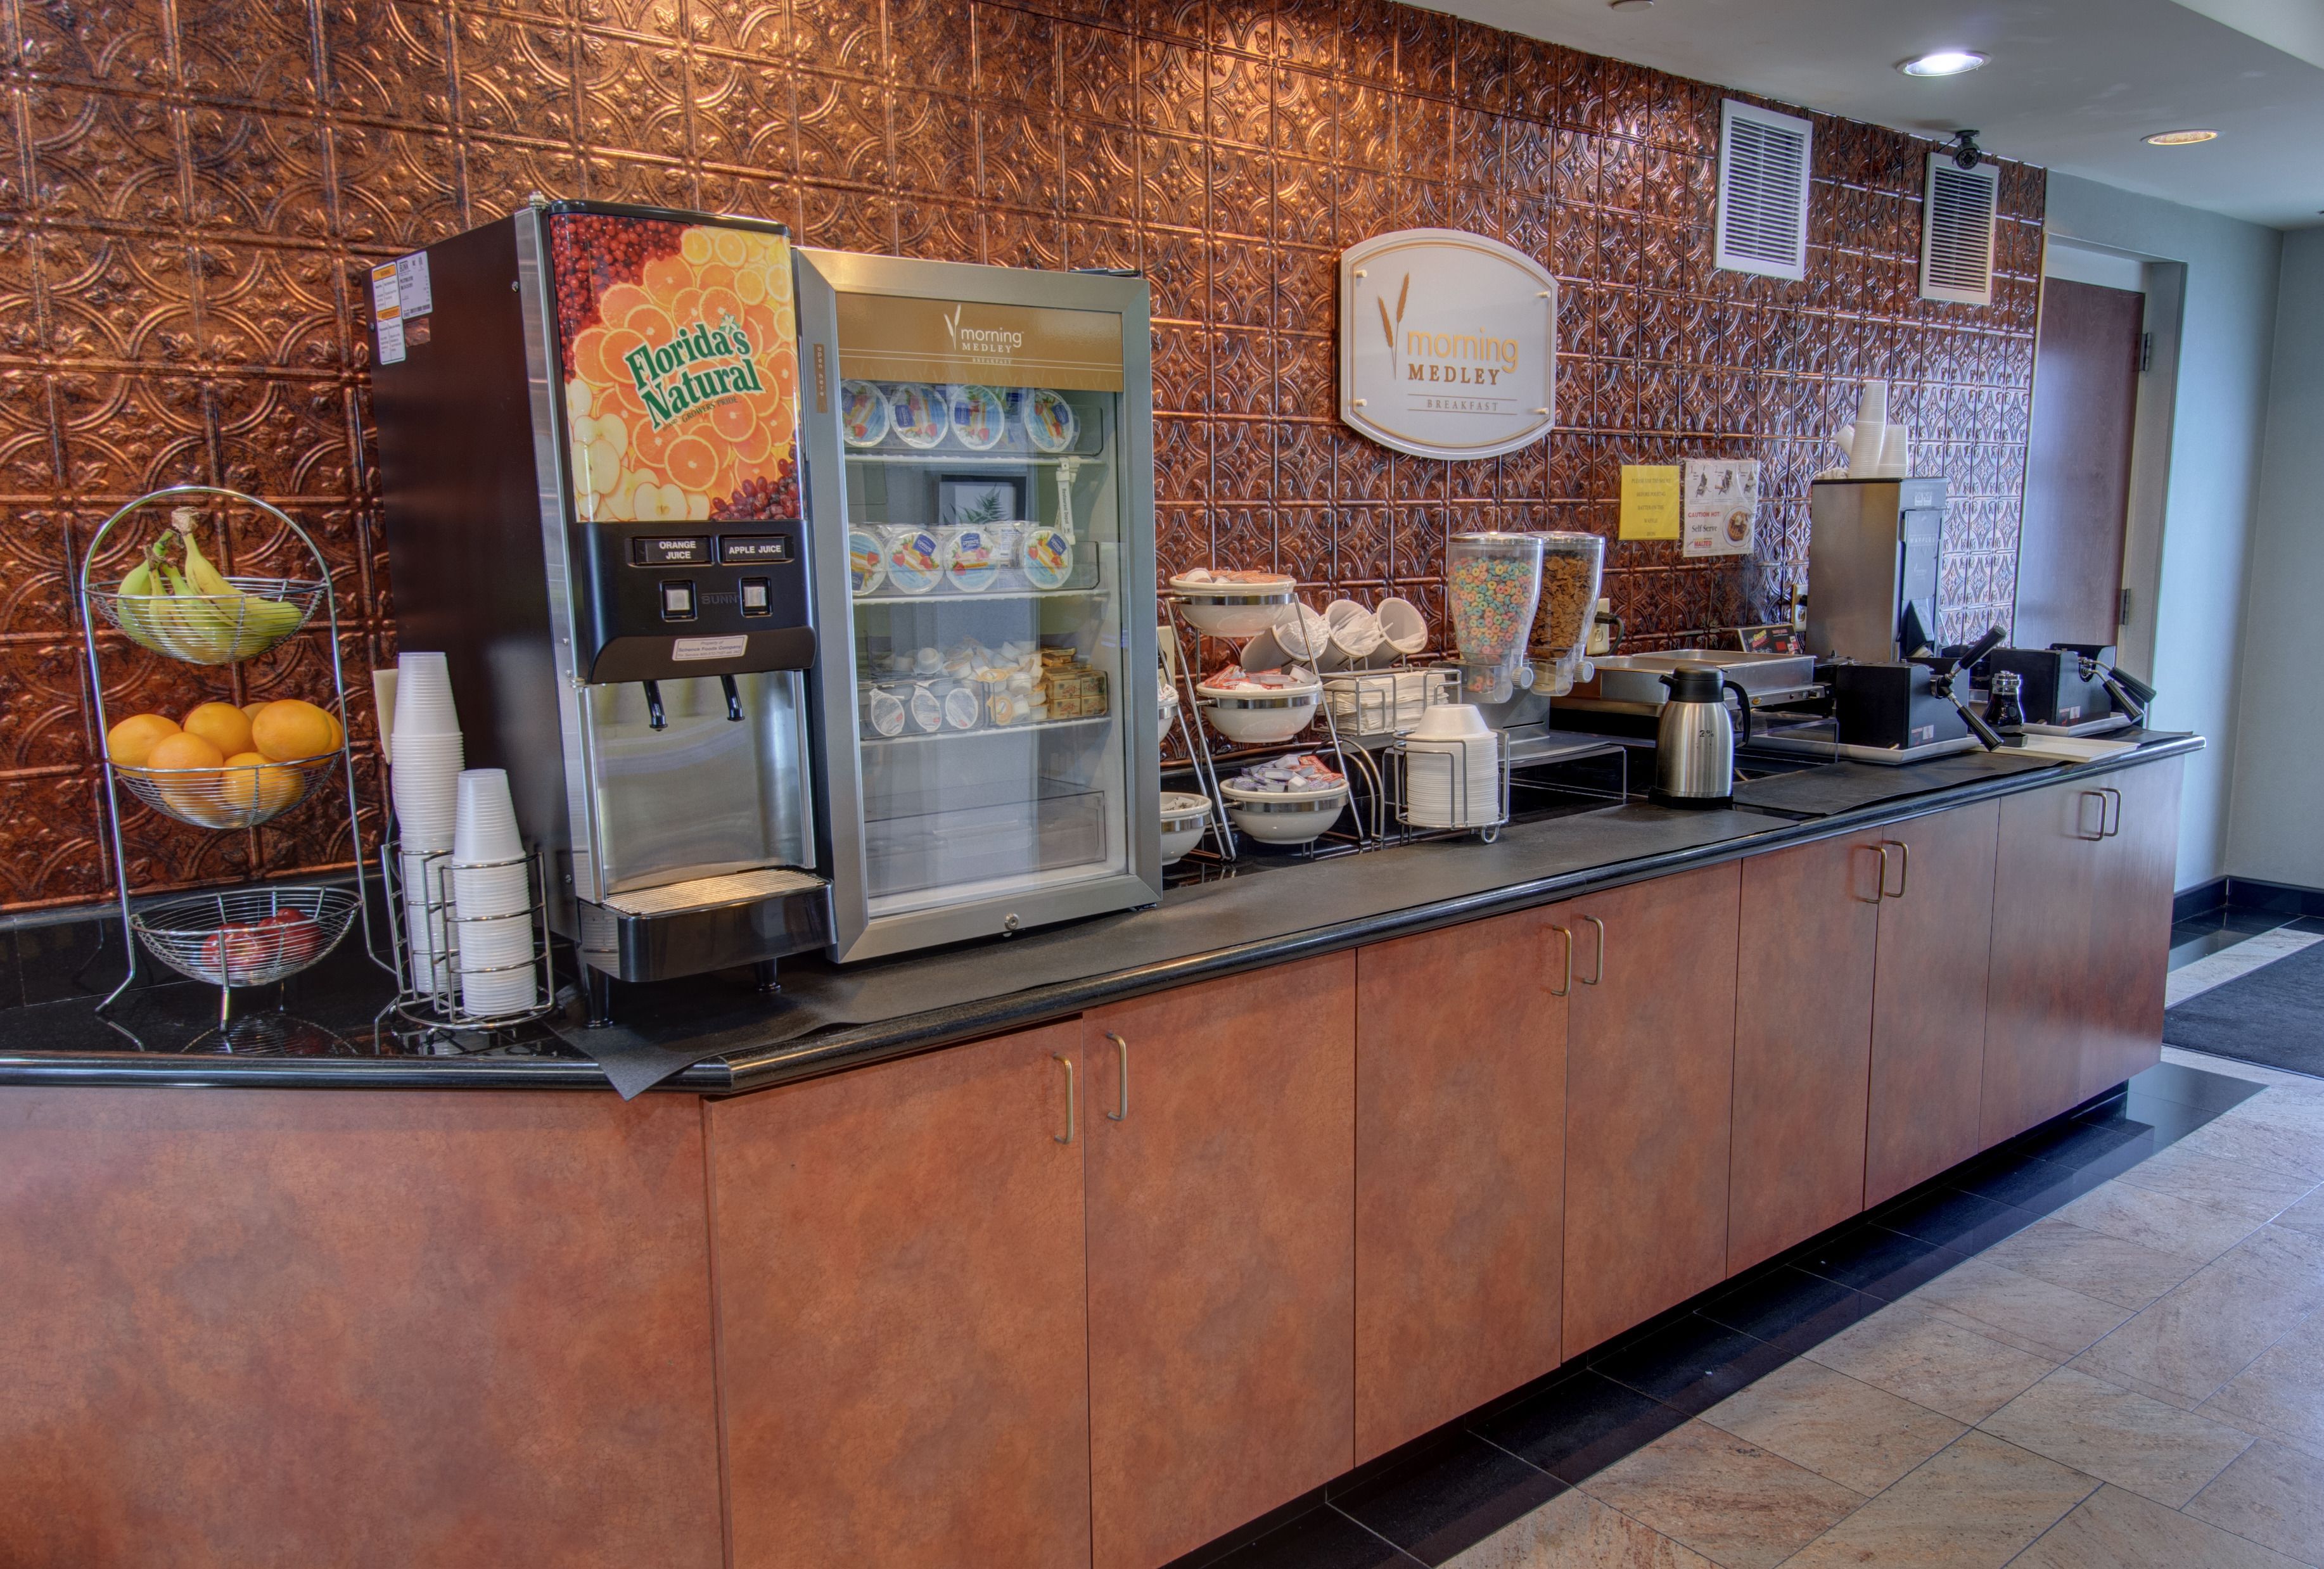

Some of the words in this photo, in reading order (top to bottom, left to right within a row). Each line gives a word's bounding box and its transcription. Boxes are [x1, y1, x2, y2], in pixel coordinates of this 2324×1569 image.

[961, 327, 1022, 348] morning
[962, 342, 1012, 353] MEDLEY
[1407, 327, 1519, 374] morning
[625, 322, 752, 390] Florida's
[1407, 363, 1500, 386] MEDLEY
[641, 357, 767, 432] Natural
[717, 396, 738, 407] PRIDE
[1427, 398, 1499, 411] BREAKFAST
[1692, 524, 1702, 533] Self
[659, 541, 696, 550] ORANGE
[729, 545, 755, 554] APPLE
[758, 545, 782, 554] JUICE
[666, 550, 691, 559] JUICE
[701, 594, 737, 605] BUNN
[1699, 730, 1714, 738] 2%
